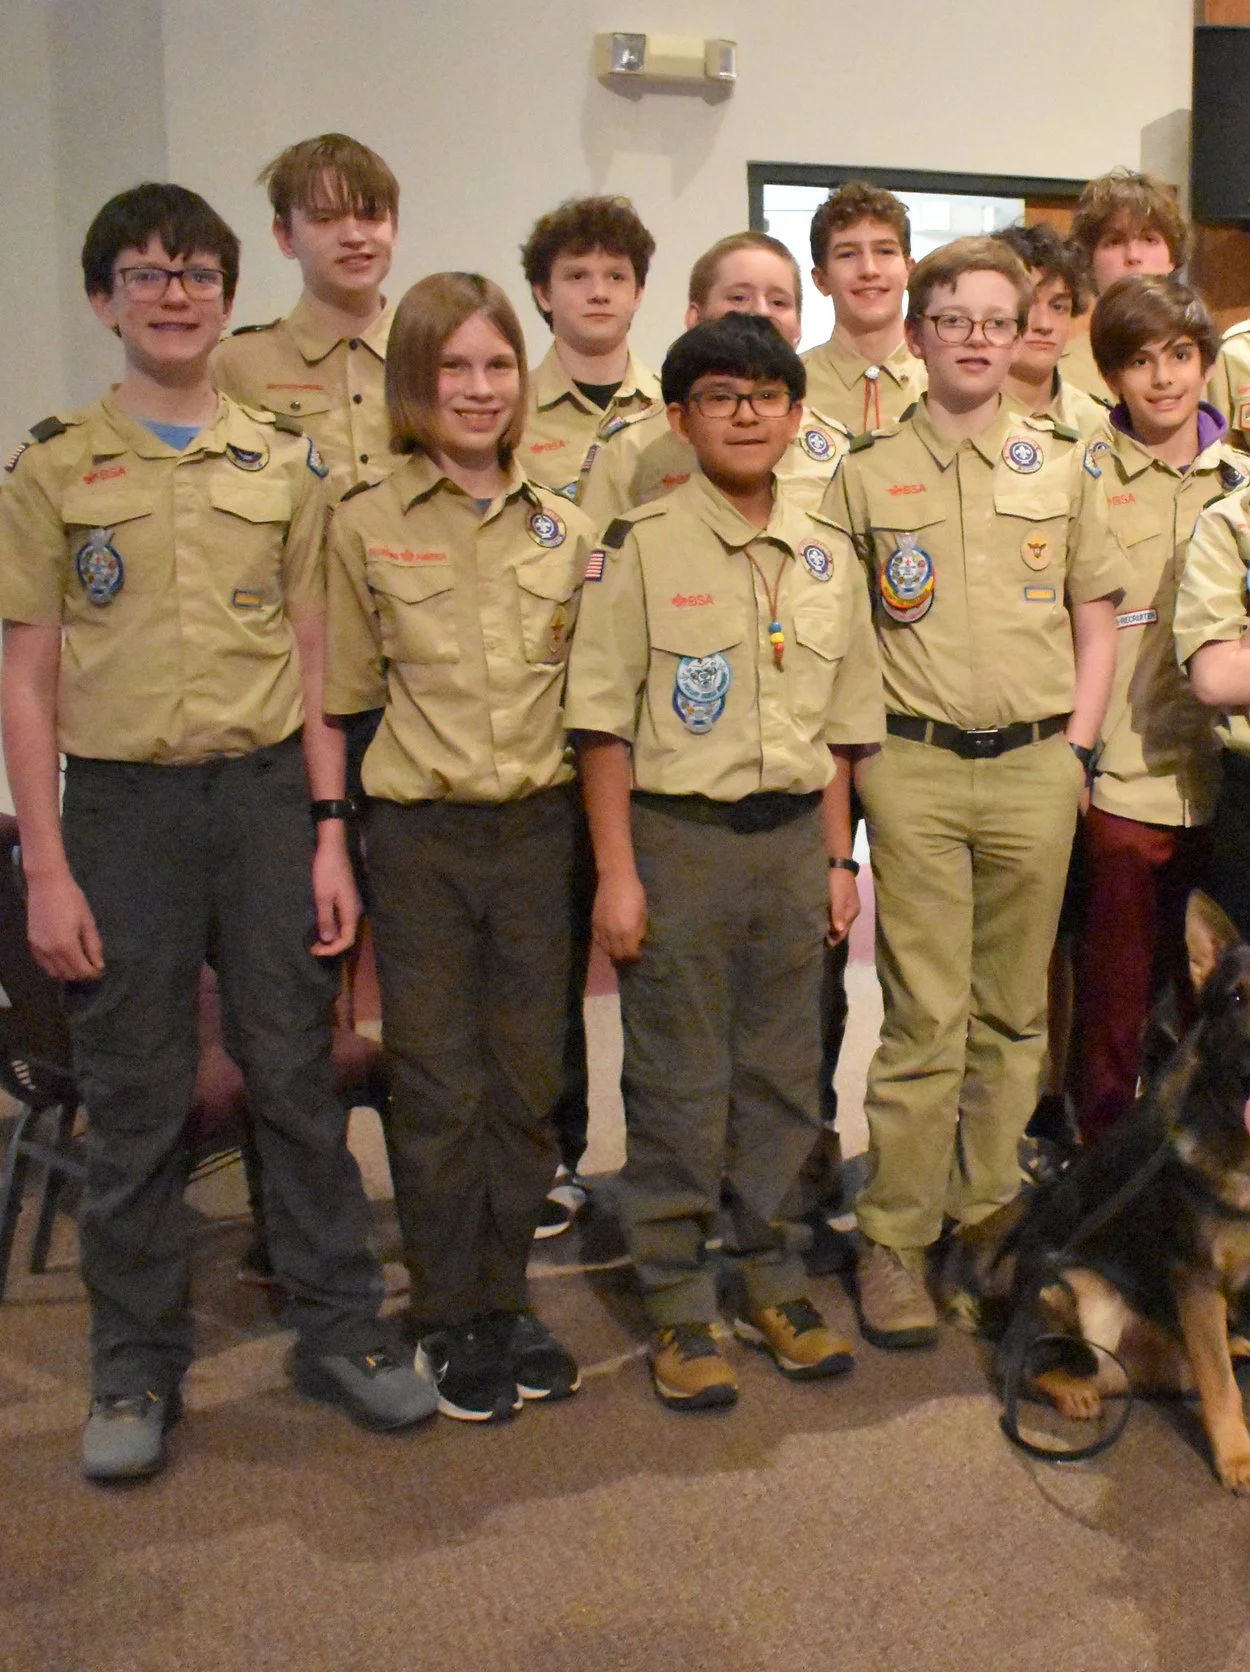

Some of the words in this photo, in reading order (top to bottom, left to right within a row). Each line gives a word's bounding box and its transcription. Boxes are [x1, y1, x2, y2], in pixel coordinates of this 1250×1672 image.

[903, 484, 926, 495] BSA
[1112, 494, 1135, 505] BSA
[687, 594, 716, 607] BSA
